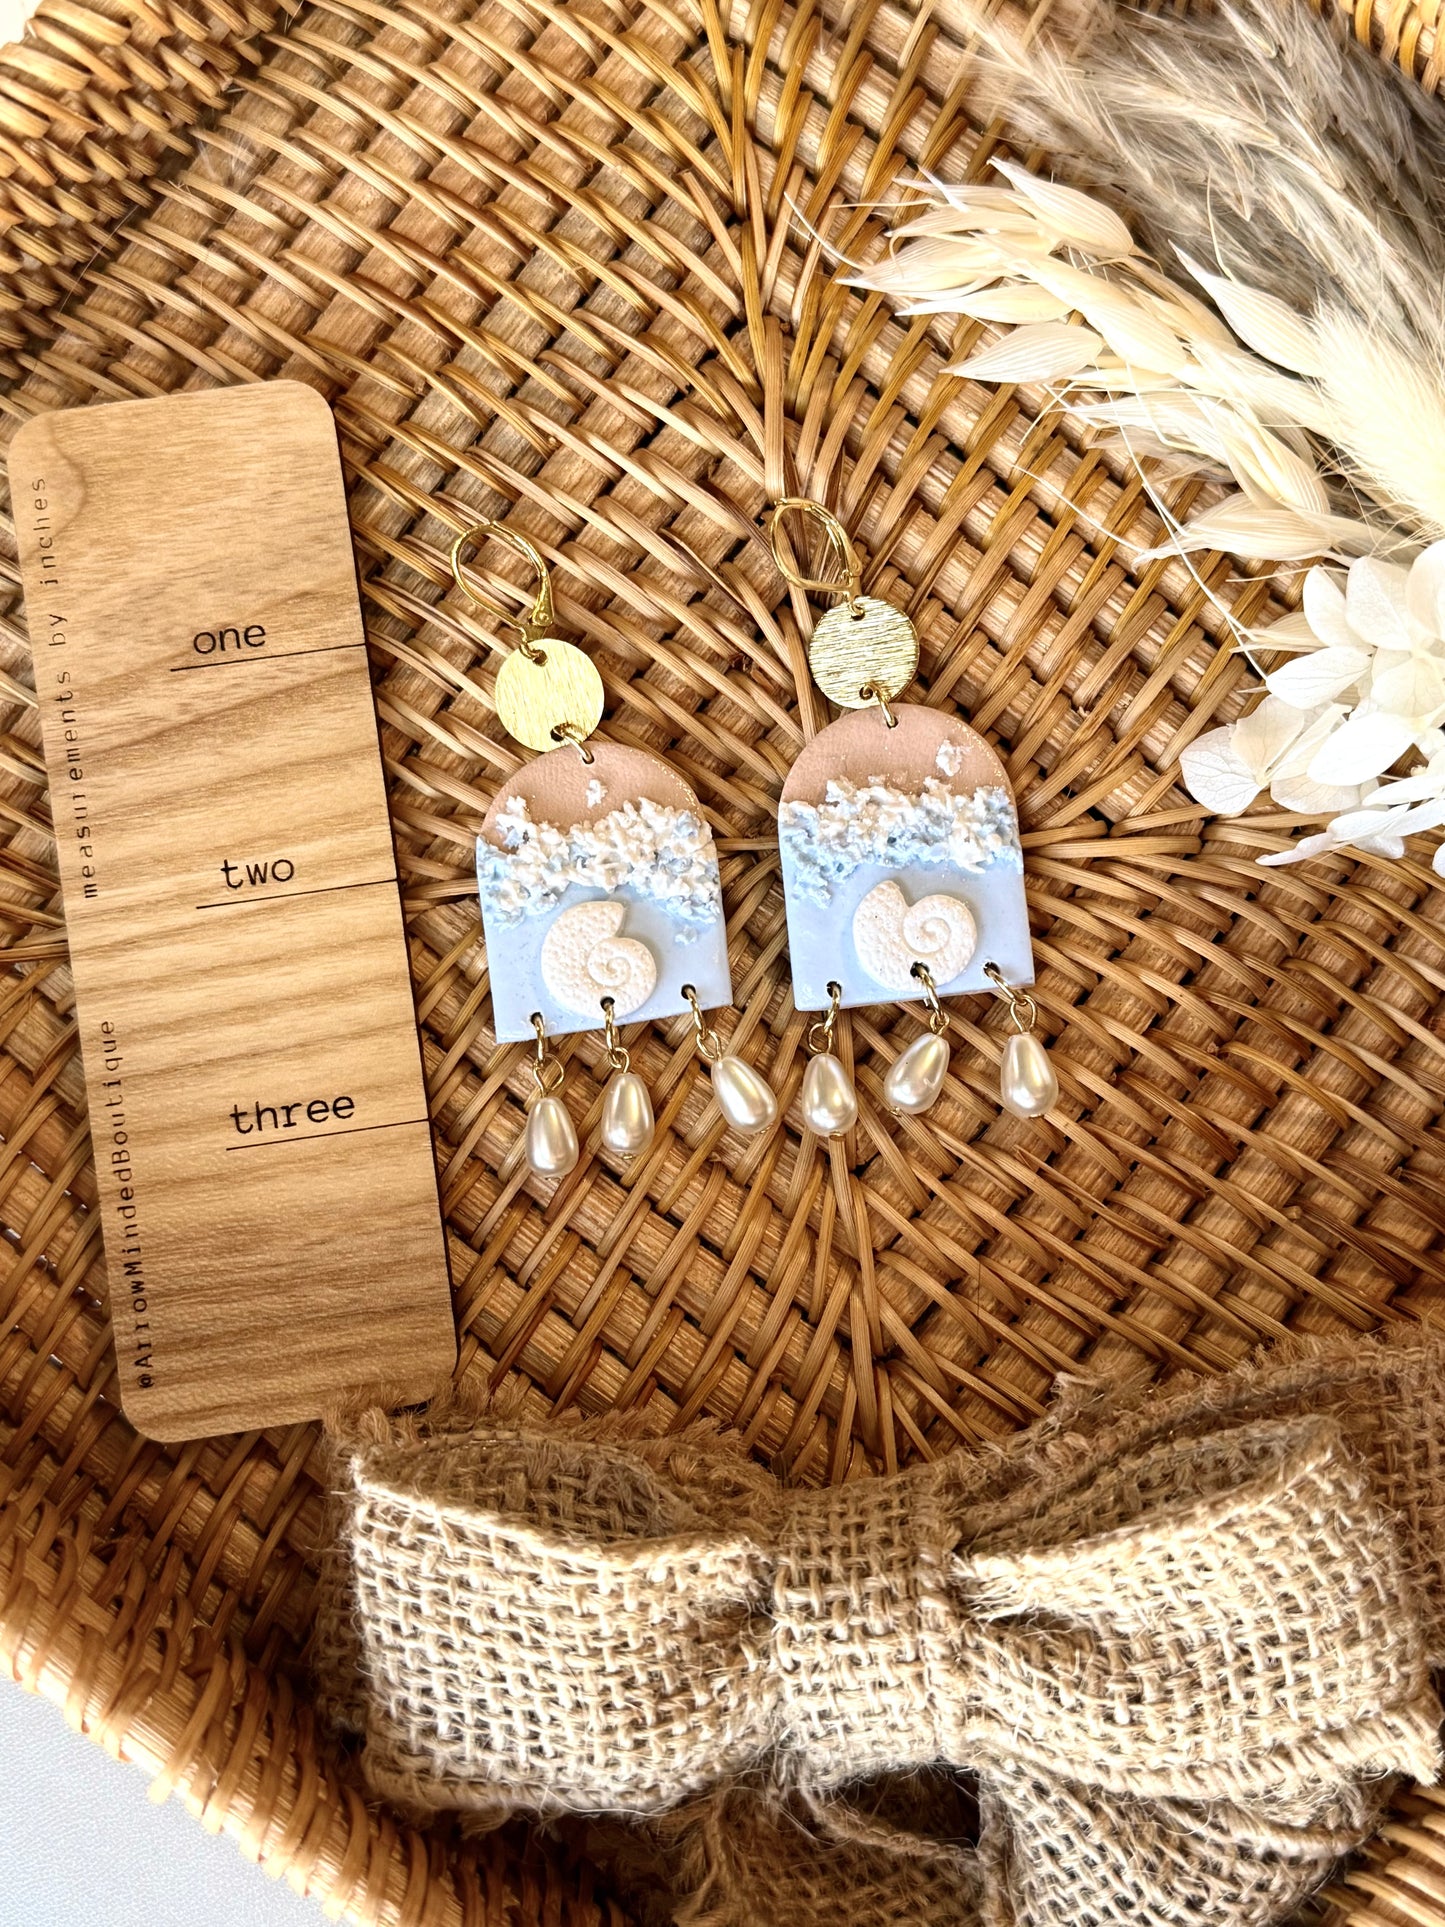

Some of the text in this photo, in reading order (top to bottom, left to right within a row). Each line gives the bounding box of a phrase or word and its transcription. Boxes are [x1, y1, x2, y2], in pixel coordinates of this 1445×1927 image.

[193, 624, 267, 655] one
[32, 478, 98, 899] measurements by inches
[220, 858, 295, 889] two
[229, 1095, 355, 1135] three
[101, 1020, 155, 1389] @ArrowMindedBoutique
